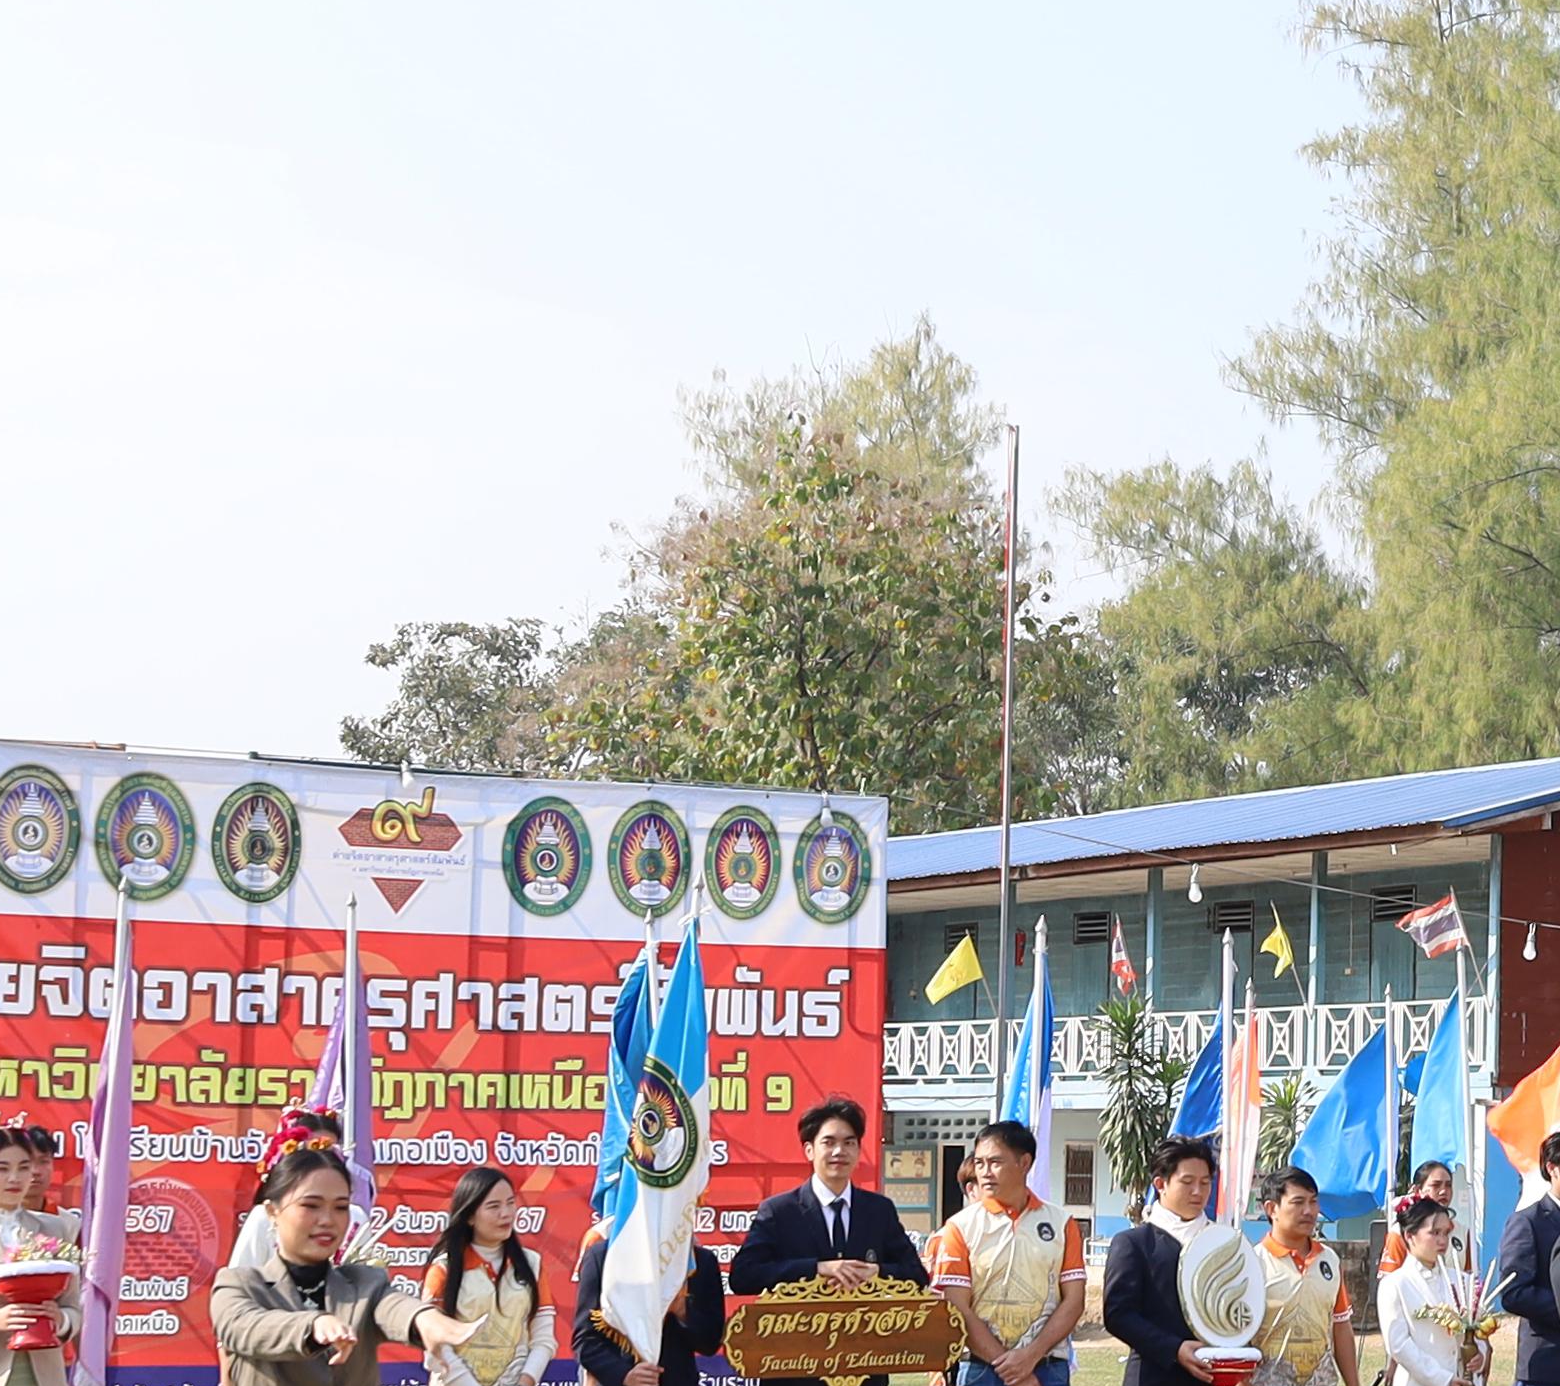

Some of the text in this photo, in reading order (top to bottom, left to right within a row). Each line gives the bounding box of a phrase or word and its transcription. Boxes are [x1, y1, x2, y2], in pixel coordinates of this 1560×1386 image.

[764, 1074, 793, 1112] 9
[756, 1300, 939, 1350] คณะครุศาสตร์
[759, 1350, 926, 1374] Faculty of Education
